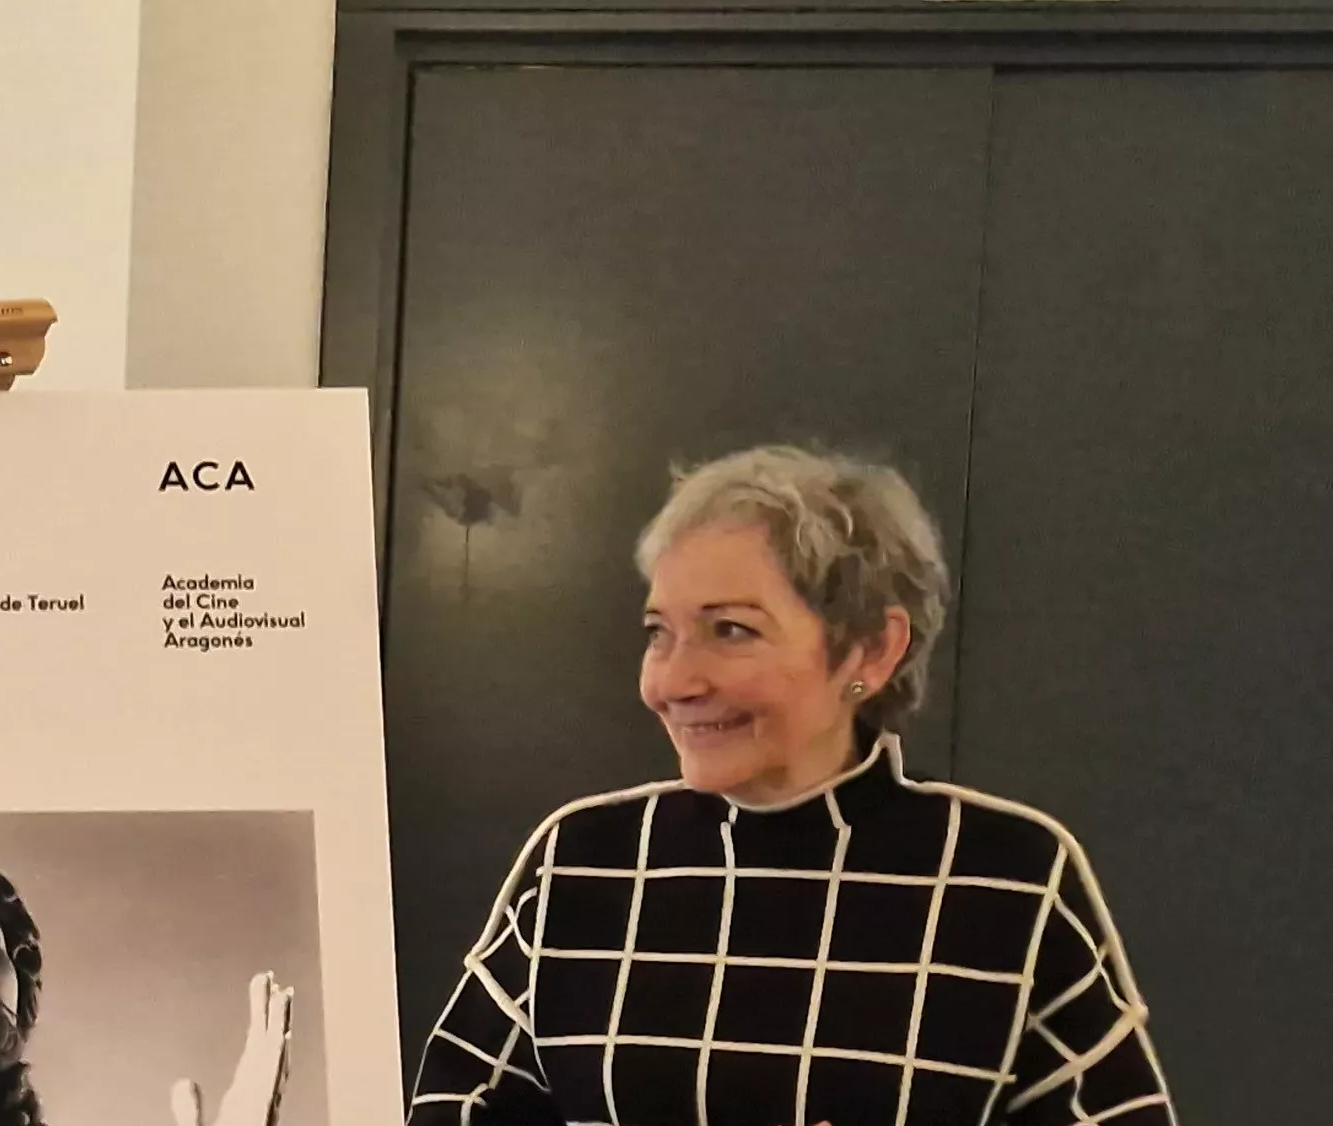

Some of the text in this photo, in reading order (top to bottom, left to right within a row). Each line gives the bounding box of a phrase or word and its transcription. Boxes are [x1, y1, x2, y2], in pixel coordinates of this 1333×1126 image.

[159, 461, 254, 491] ACA
[161, 573, 255, 591] Academia
[0, 594, 22, 612] de
[27, 593, 85, 612] Teruel
[162, 593, 239, 610] del Cine
[162, 610, 306, 633] y el Audiovisual
[163, 630, 253, 652] Aragonés
